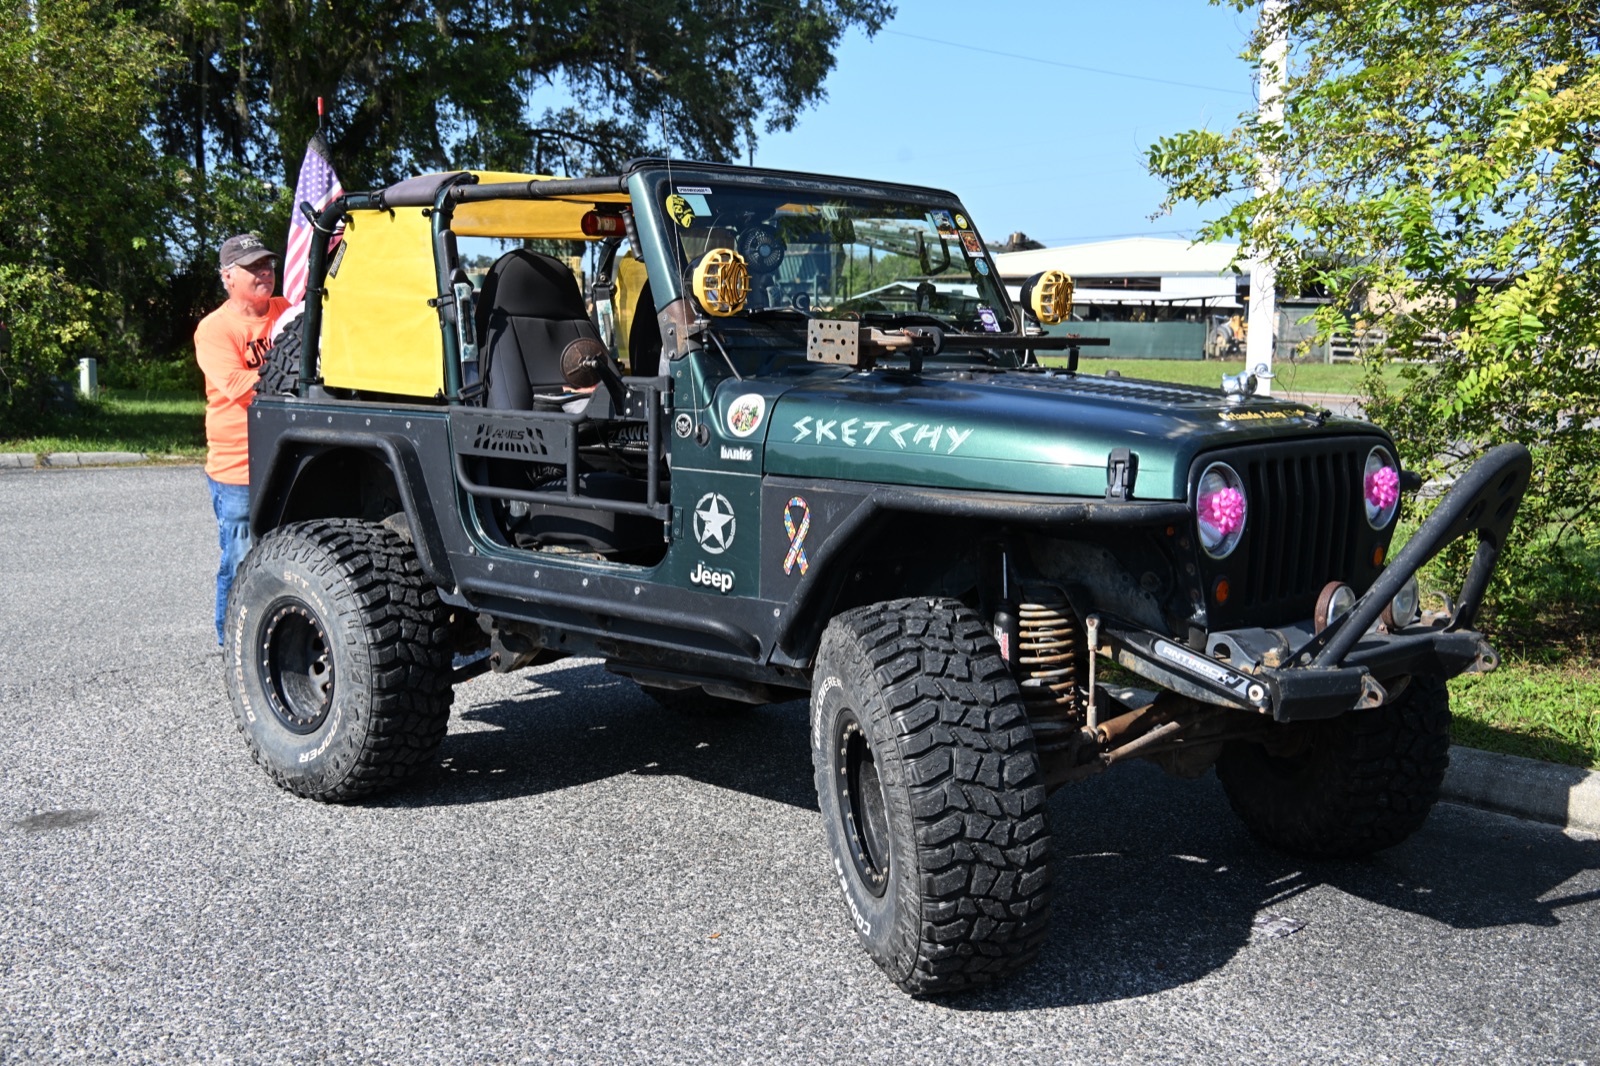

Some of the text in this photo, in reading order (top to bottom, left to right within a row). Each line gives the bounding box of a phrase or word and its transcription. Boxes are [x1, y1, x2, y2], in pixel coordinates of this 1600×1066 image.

[792, 415, 974, 455] SKETCHY
[283, 570, 309, 589] STT
[690, 562, 734, 592] Jeep
[234, 605, 256, 723] DISCOVERER
[299, 703, 342, 763] COOPER
[834, 857, 871, 937] COOPER
